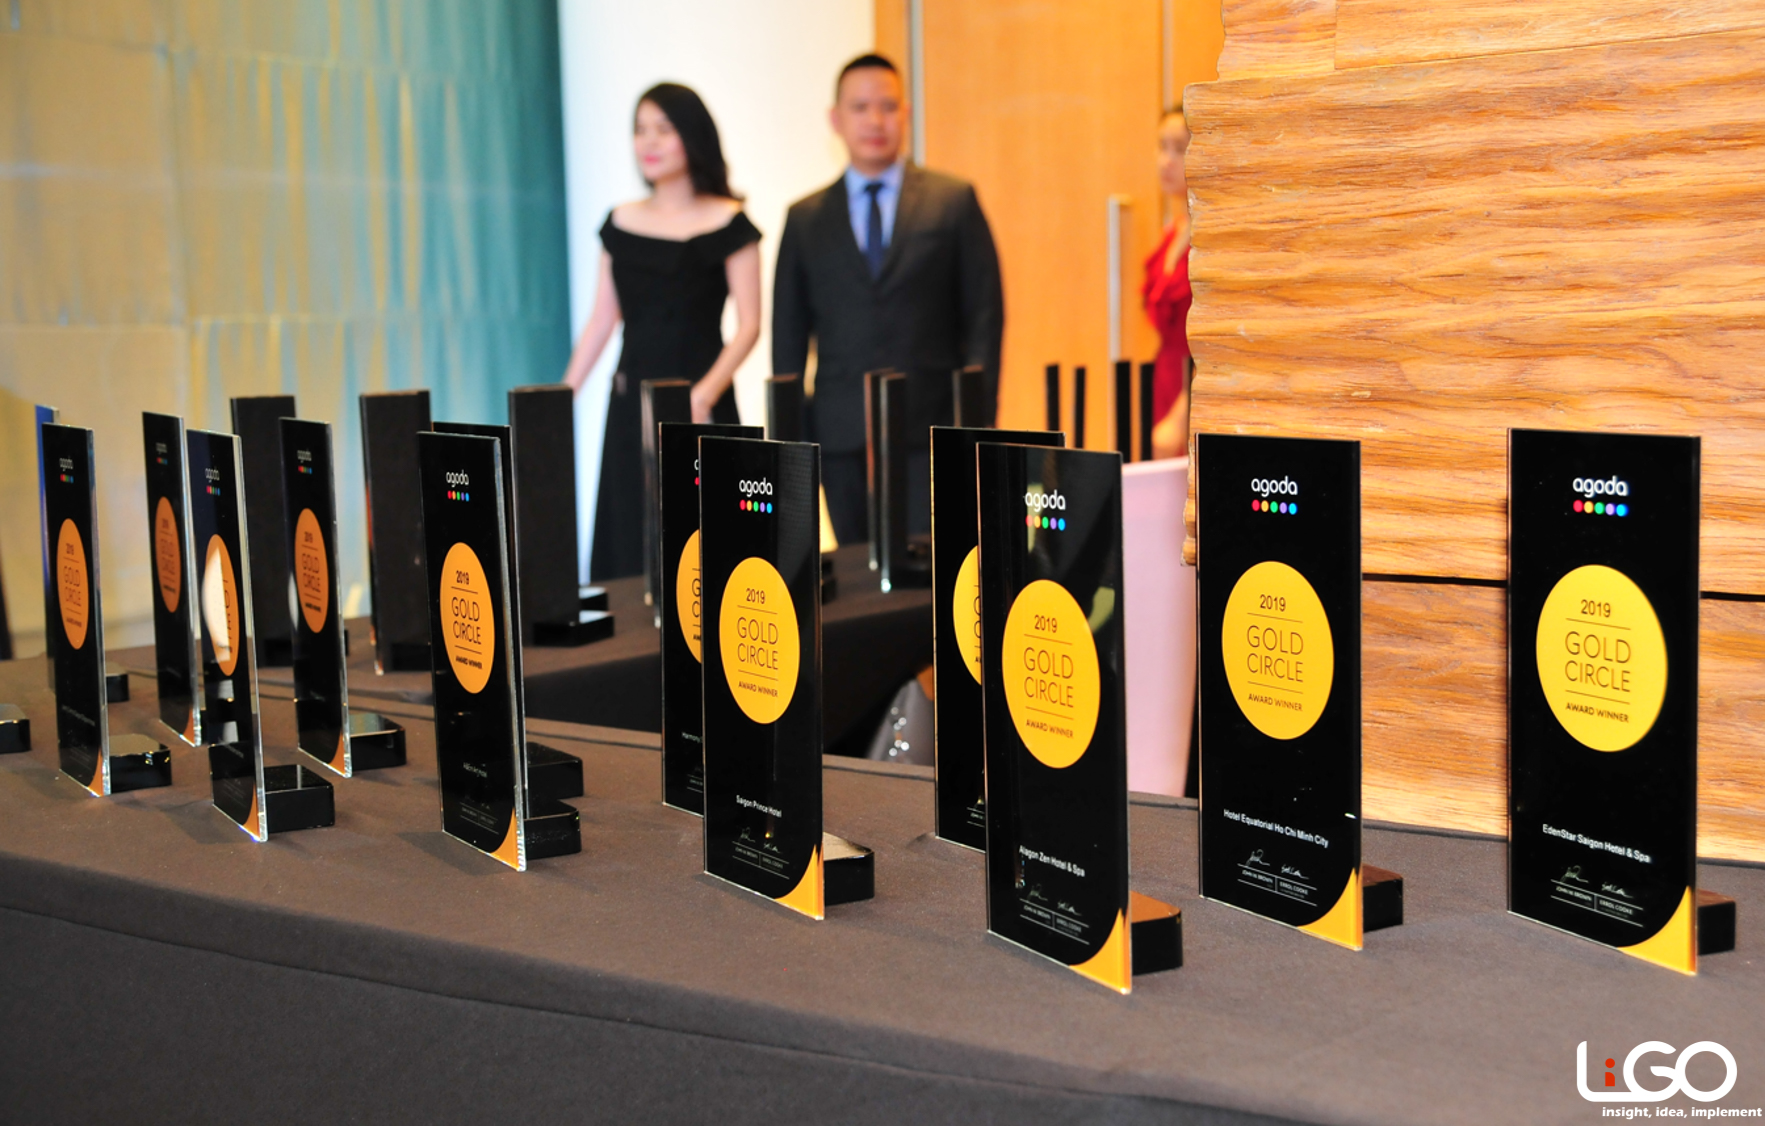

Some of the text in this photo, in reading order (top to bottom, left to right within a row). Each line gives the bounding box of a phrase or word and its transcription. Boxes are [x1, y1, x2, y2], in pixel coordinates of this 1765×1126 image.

[446, 469, 469, 488] agoda
[739, 477, 773, 498] agoda
[1251, 475, 1298, 498] agoda
[1572, 475, 1629, 498] agoda
[1024, 489, 1067, 513] agoda
[746, 588, 766, 605] 2019
[1259, 594, 1286, 612] 2019
[1581, 599, 1611, 618] 2019
[451, 596, 480, 622] GOLD
[453, 620, 482, 645] CIRCLE
[737, 616, 779, 645] GOLD
[1034, 614, 1058, 634] 2019
[1246, 625, 1304, 655] GOLD
[1564, 631, 1631, 664] GOLD
[737, 642, 779, 671] CIRCLE
[1023, 646, 1074, 679] GOLD
[1247, 652, 1304, 683] CIRCLE
[1564, 660, 1631, 693] CIRCLE
[738, 681, 778, 698] AWARD WINNER
[1024, 676, 1074, 708] CIRCLE
[1248, 693, 1303, 712] AWARD WINNER
[1565, 702, 1630, 723] AWARD WINNER
[1025, 719, 1074, 739] AWARD WINNER
[736, 794, 753, 808] Saigon
[768, 807, 782, 818] Hotel
[1223, 809, 1240, 821] Hotel
[1241, 814, 1274, 831] Equatorial
[1285, 826, 1296, 838] Chi
[1297, 829, 1314, 842] Minh
[1314, 835, 1329, 848] City
[1542, 823, 1652, 863] EdenStar Saigon Hotel & Spa
[1051, 856, 1067, 870] Hotel
[1073, 863, 1085, 877] Spa
